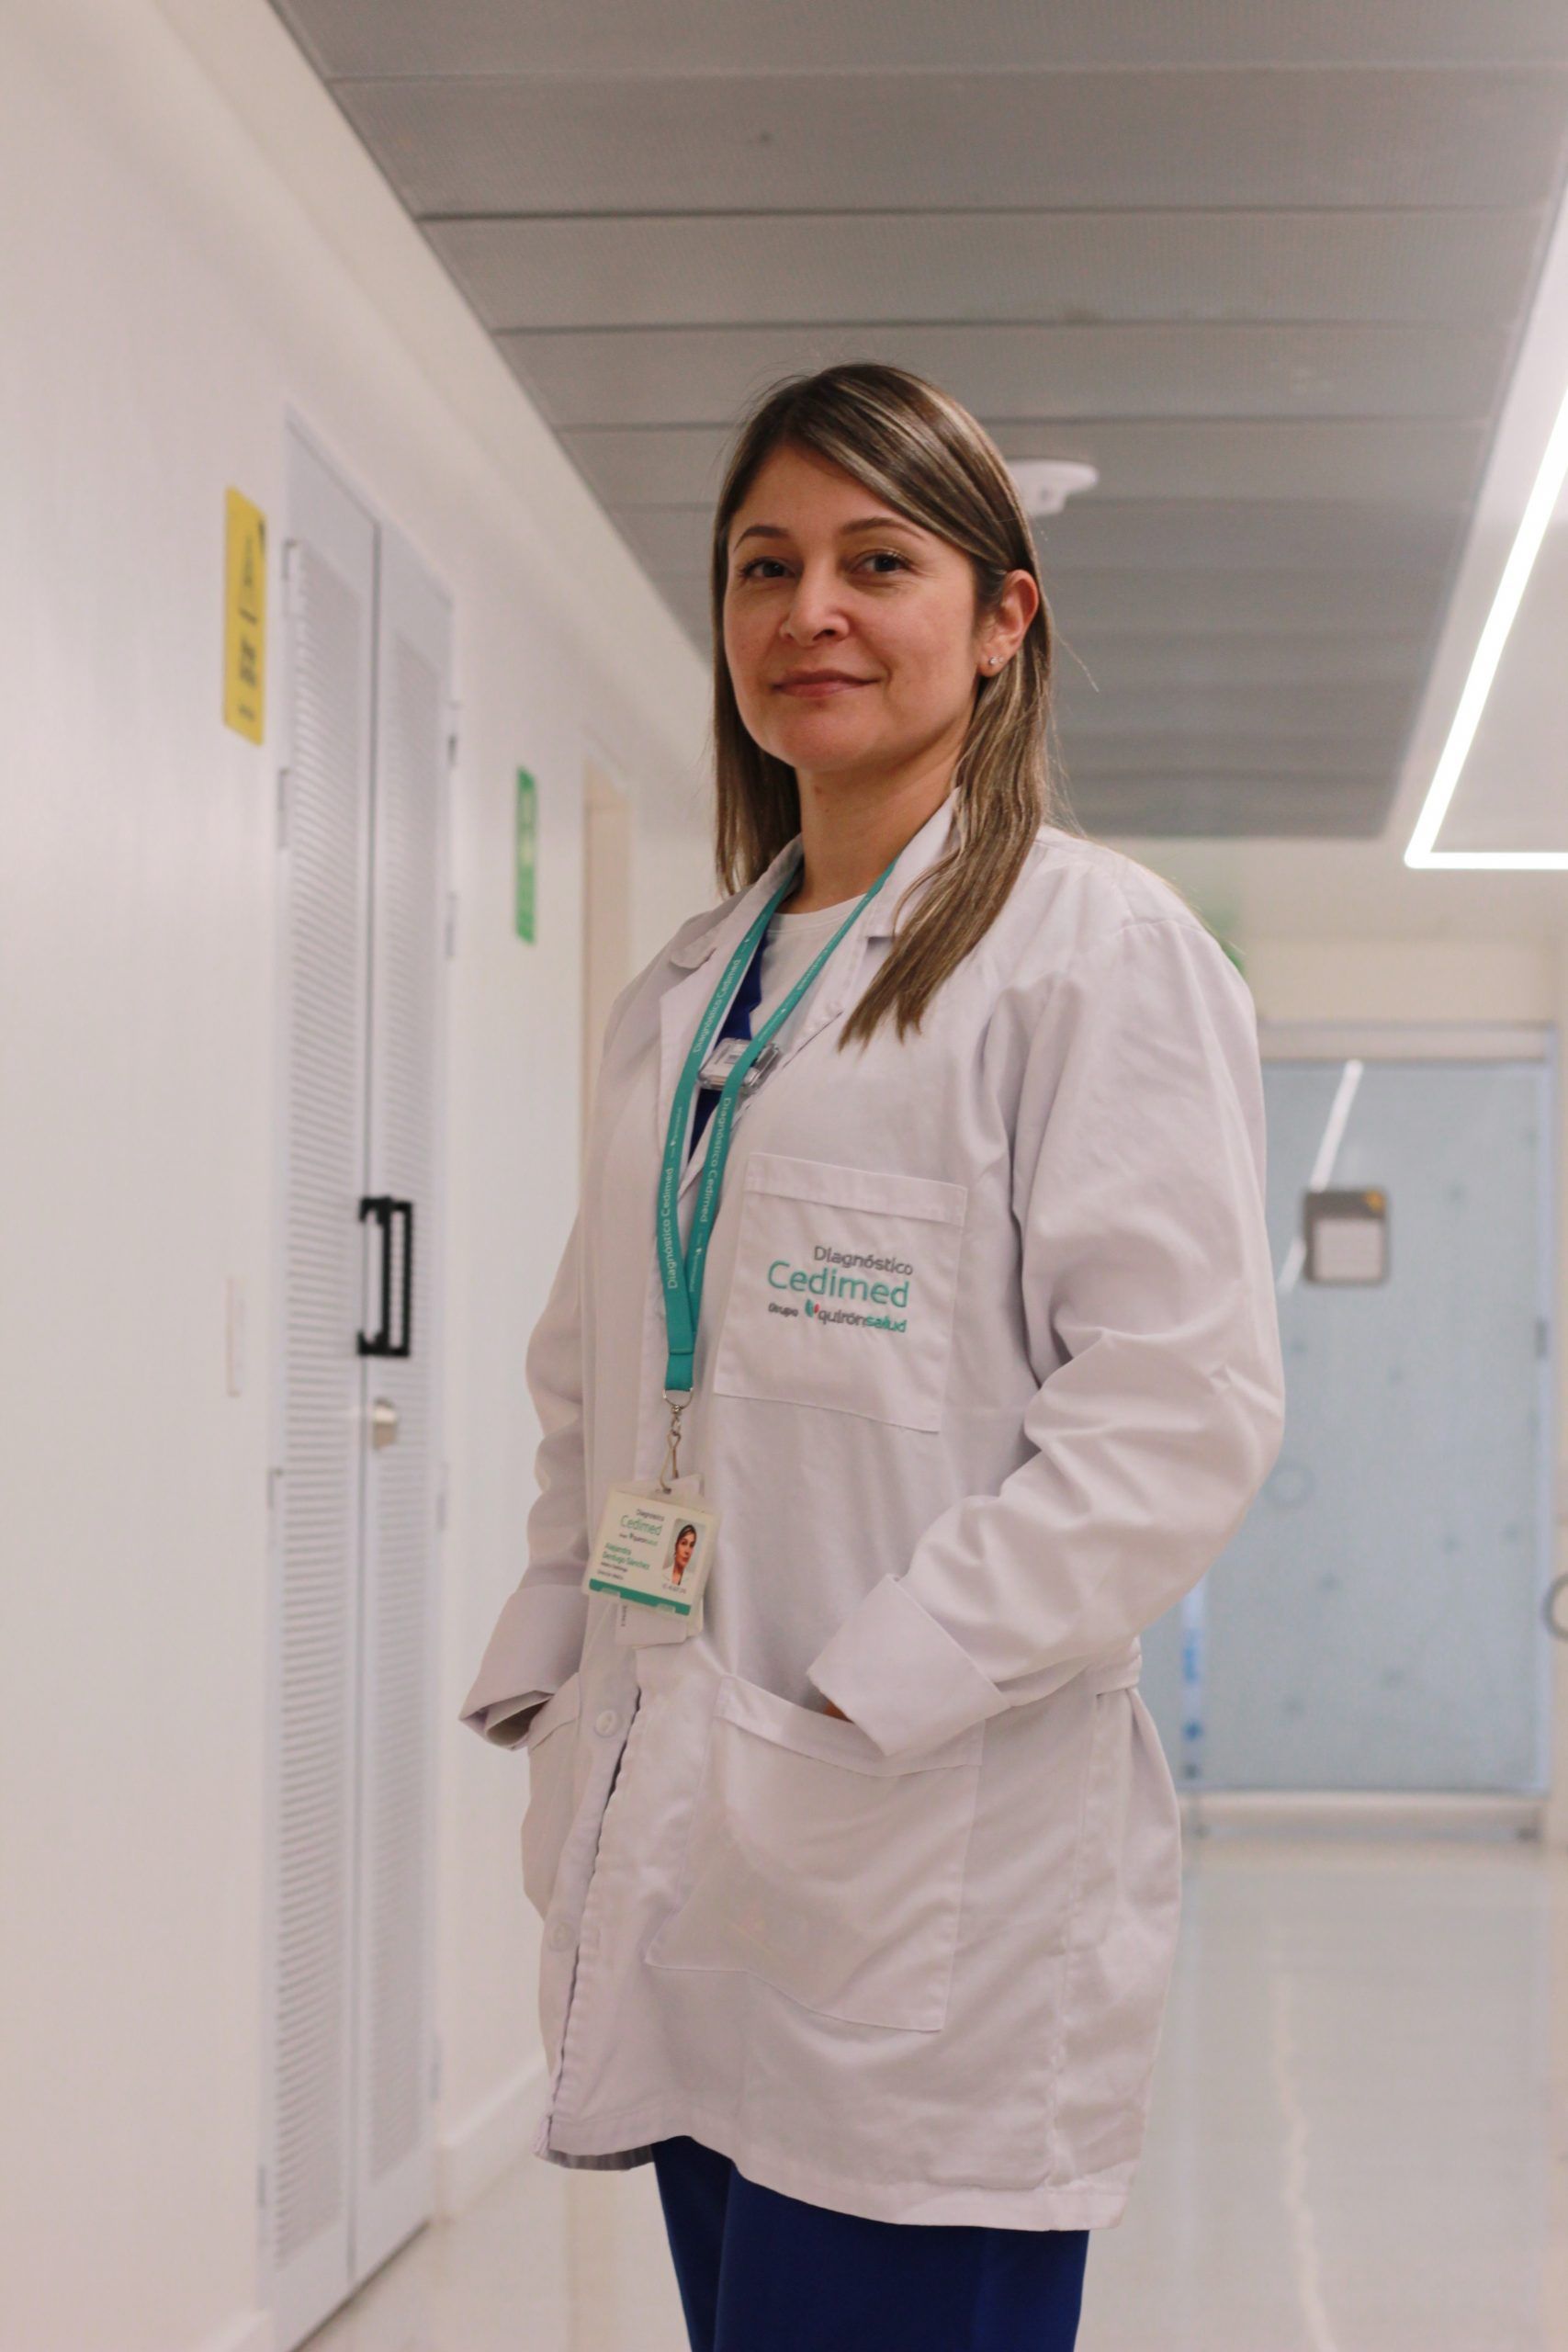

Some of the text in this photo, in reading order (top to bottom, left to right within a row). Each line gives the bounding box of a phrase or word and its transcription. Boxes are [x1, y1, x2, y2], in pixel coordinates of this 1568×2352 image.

[700, 1169, 718, 1223] Cedimed
[660, 1167, 678, 1290] Diagnóstico Cedimed
[768, 1260, 910, 1309] Cedimed
[814, 1245, 914, 1276] Diagnóstico
[768, 1302, 799, 1317] Grupo
